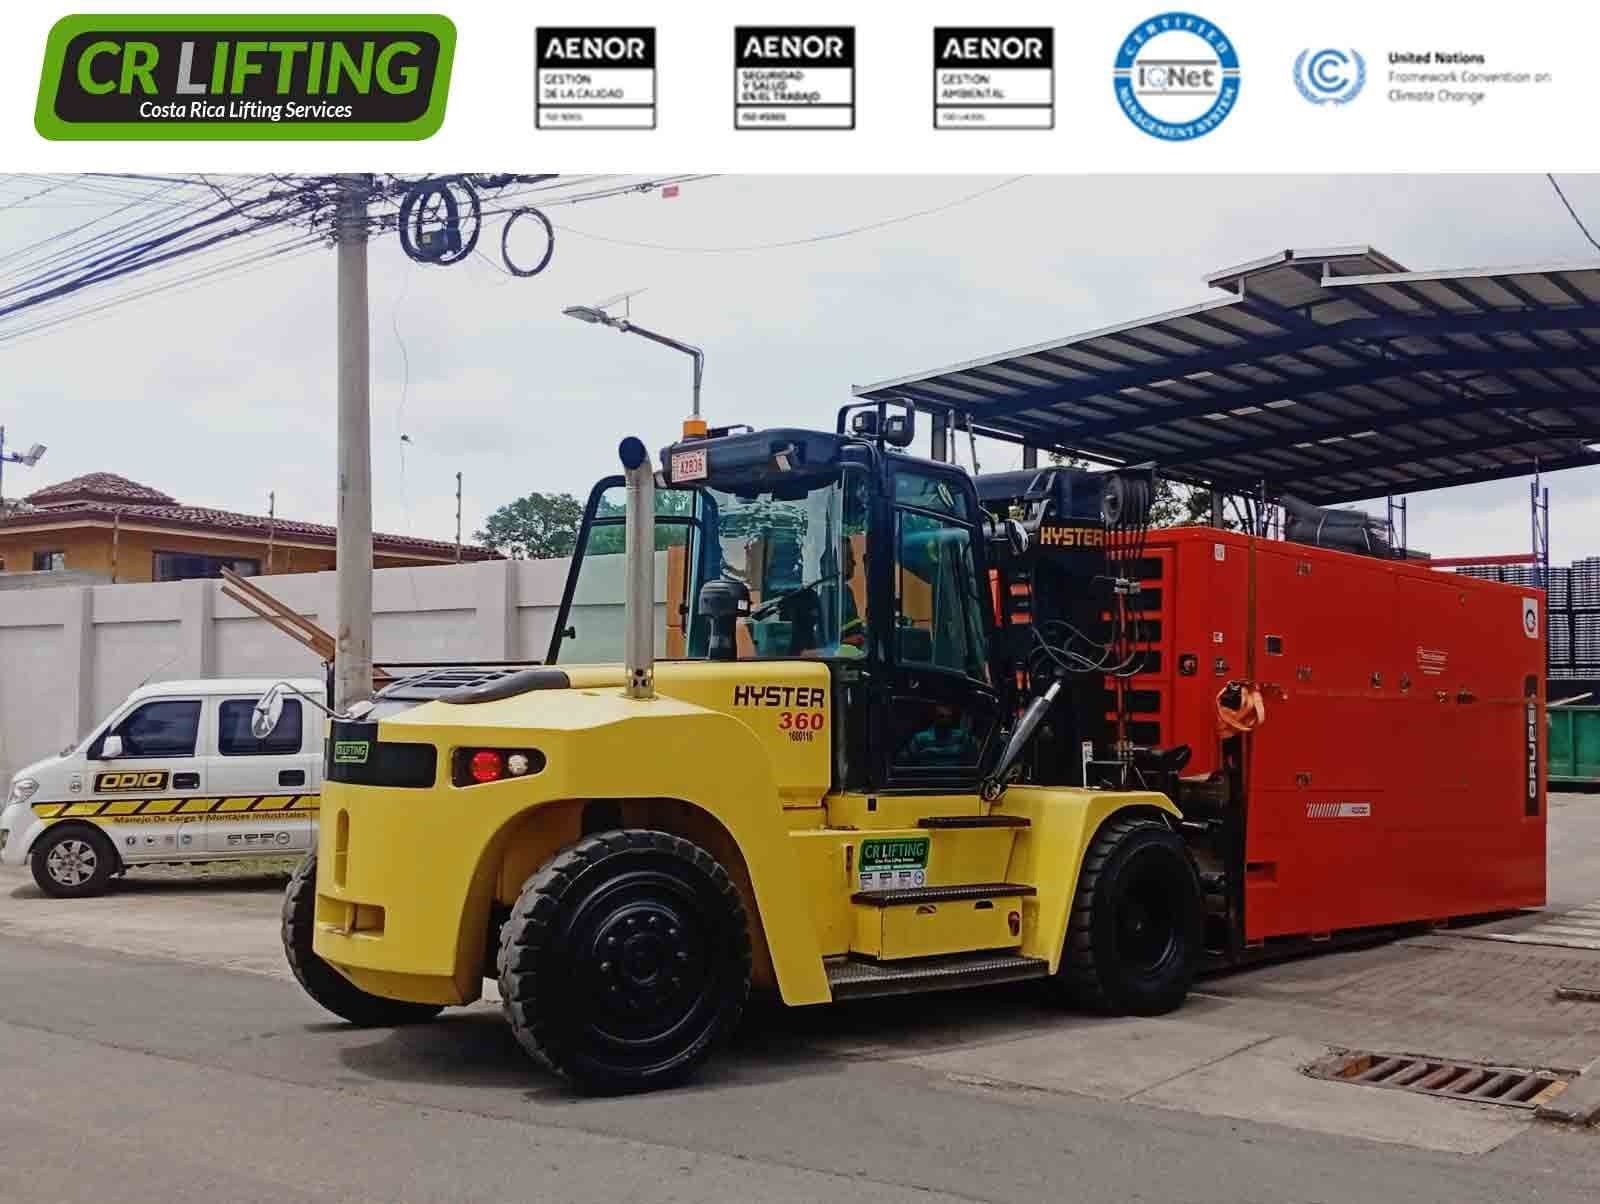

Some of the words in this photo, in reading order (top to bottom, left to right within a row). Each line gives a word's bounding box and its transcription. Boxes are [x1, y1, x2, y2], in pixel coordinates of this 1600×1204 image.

[1040, 526, 1104, 546] HYSTER
[734, 685, 825, 708] HYSTER
[779, 712, 825, 730] 360
[100, 773, 163, 788] ODIO
[113, 815, 151, 825] Manejo
[207, 813, 250, 824] Montajes
[252, 811, 307, 820] Industriales
[864, 845, 880, 858] CR
[882, 842, 924, 858] LIFTING
